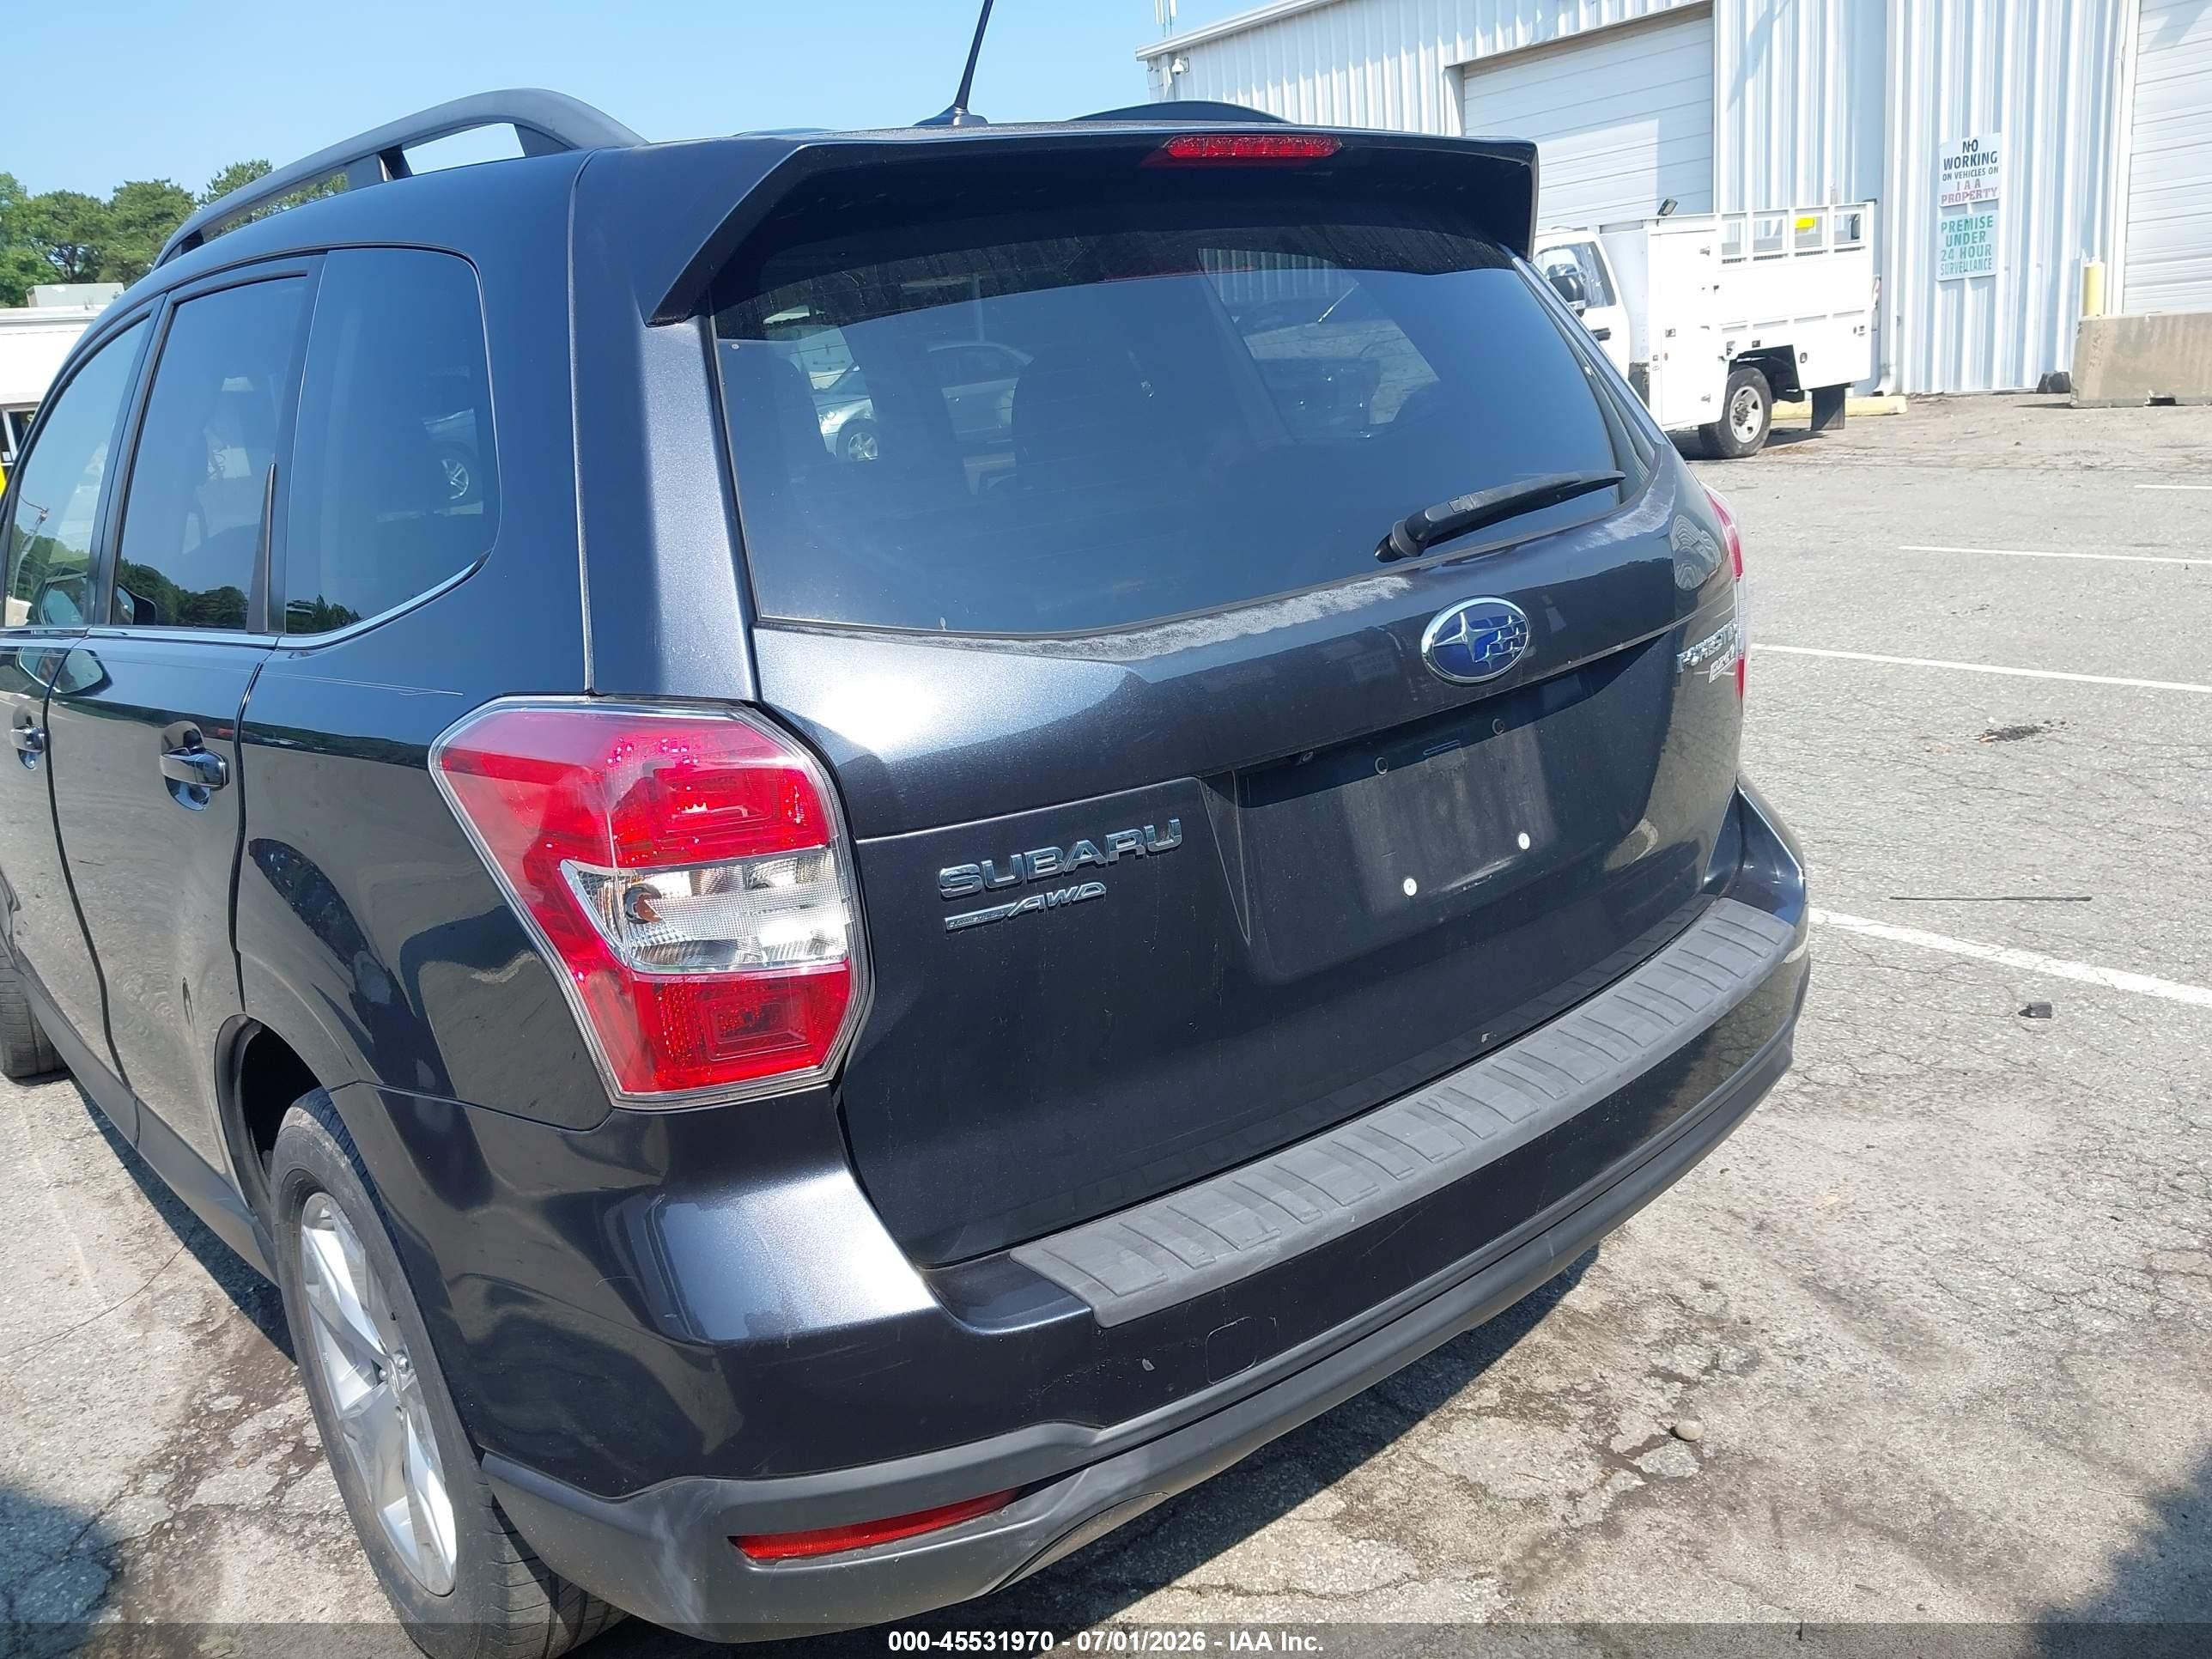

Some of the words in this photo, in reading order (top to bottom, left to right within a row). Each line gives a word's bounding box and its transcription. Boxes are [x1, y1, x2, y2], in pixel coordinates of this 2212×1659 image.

[1962, 139, 1978, 153] NO
[1944, 151, 1997, 170] WORKING
[1942, 173, 1952, 181] ON
[1954, 167, 1985, 179] VEHICLES
[1988, 166, 1999, 174] ON
[1942, 187, 1997, 204] PROPERTY
[1941, 216, 1993, 234] PREMISE
[1946, 230, 1985, 247] UNDER
[1941, 248, 1954, 261] 24
[1960, 244, 1991, 259] HOUR
[1941, 258, 1991, 275] SURVEILLANCE
[939, 818, 1182, 898] SUBARU
[1007, 882, 1106, 917] AWD
